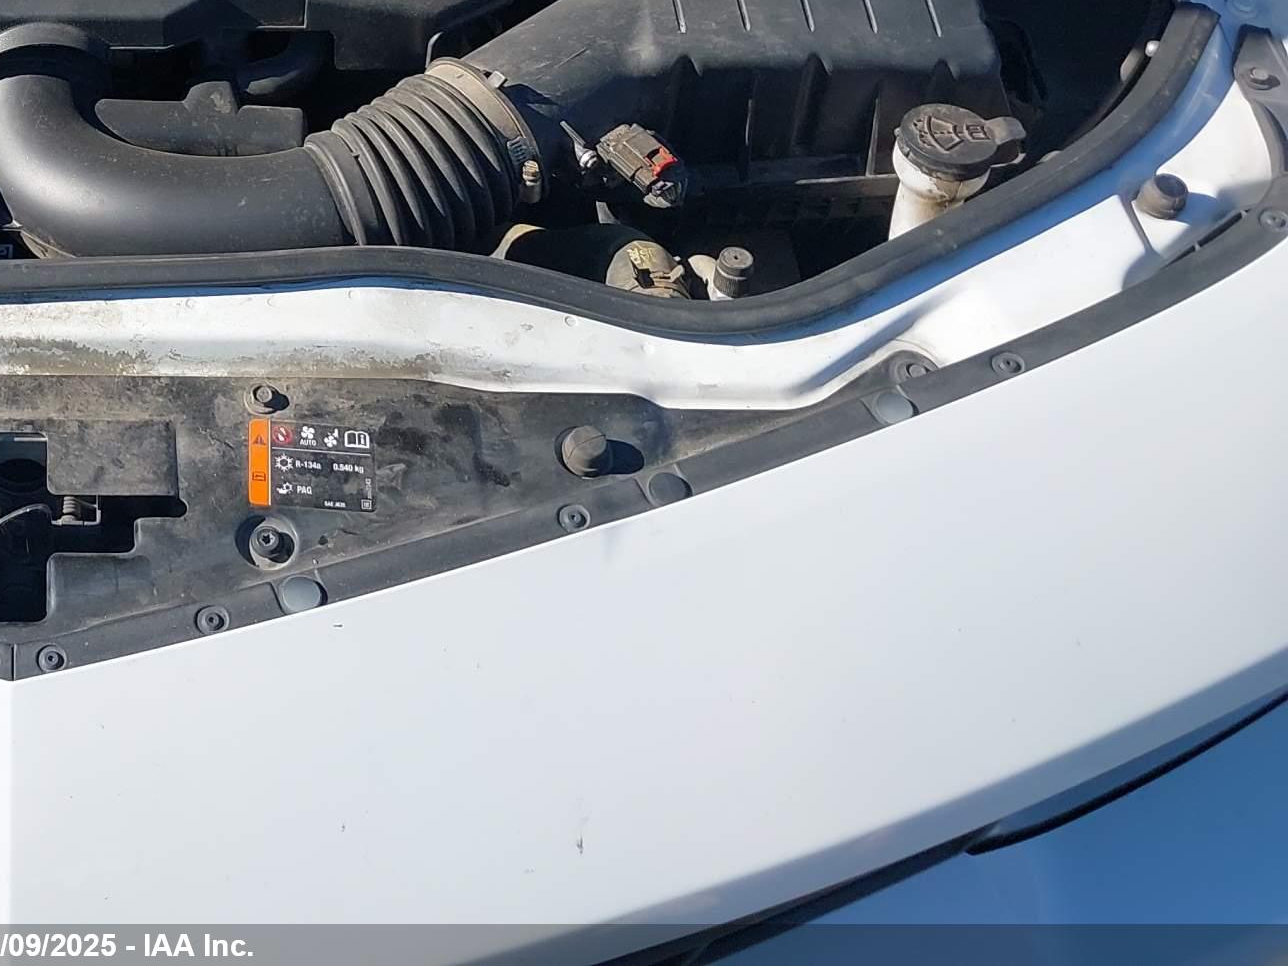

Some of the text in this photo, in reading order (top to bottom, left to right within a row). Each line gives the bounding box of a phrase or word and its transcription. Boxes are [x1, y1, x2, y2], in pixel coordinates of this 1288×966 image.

[299, 438, 317, 446] AUTO
[295, 460, 322, 470] R-134a
[354, 464, 364, 474] kg
